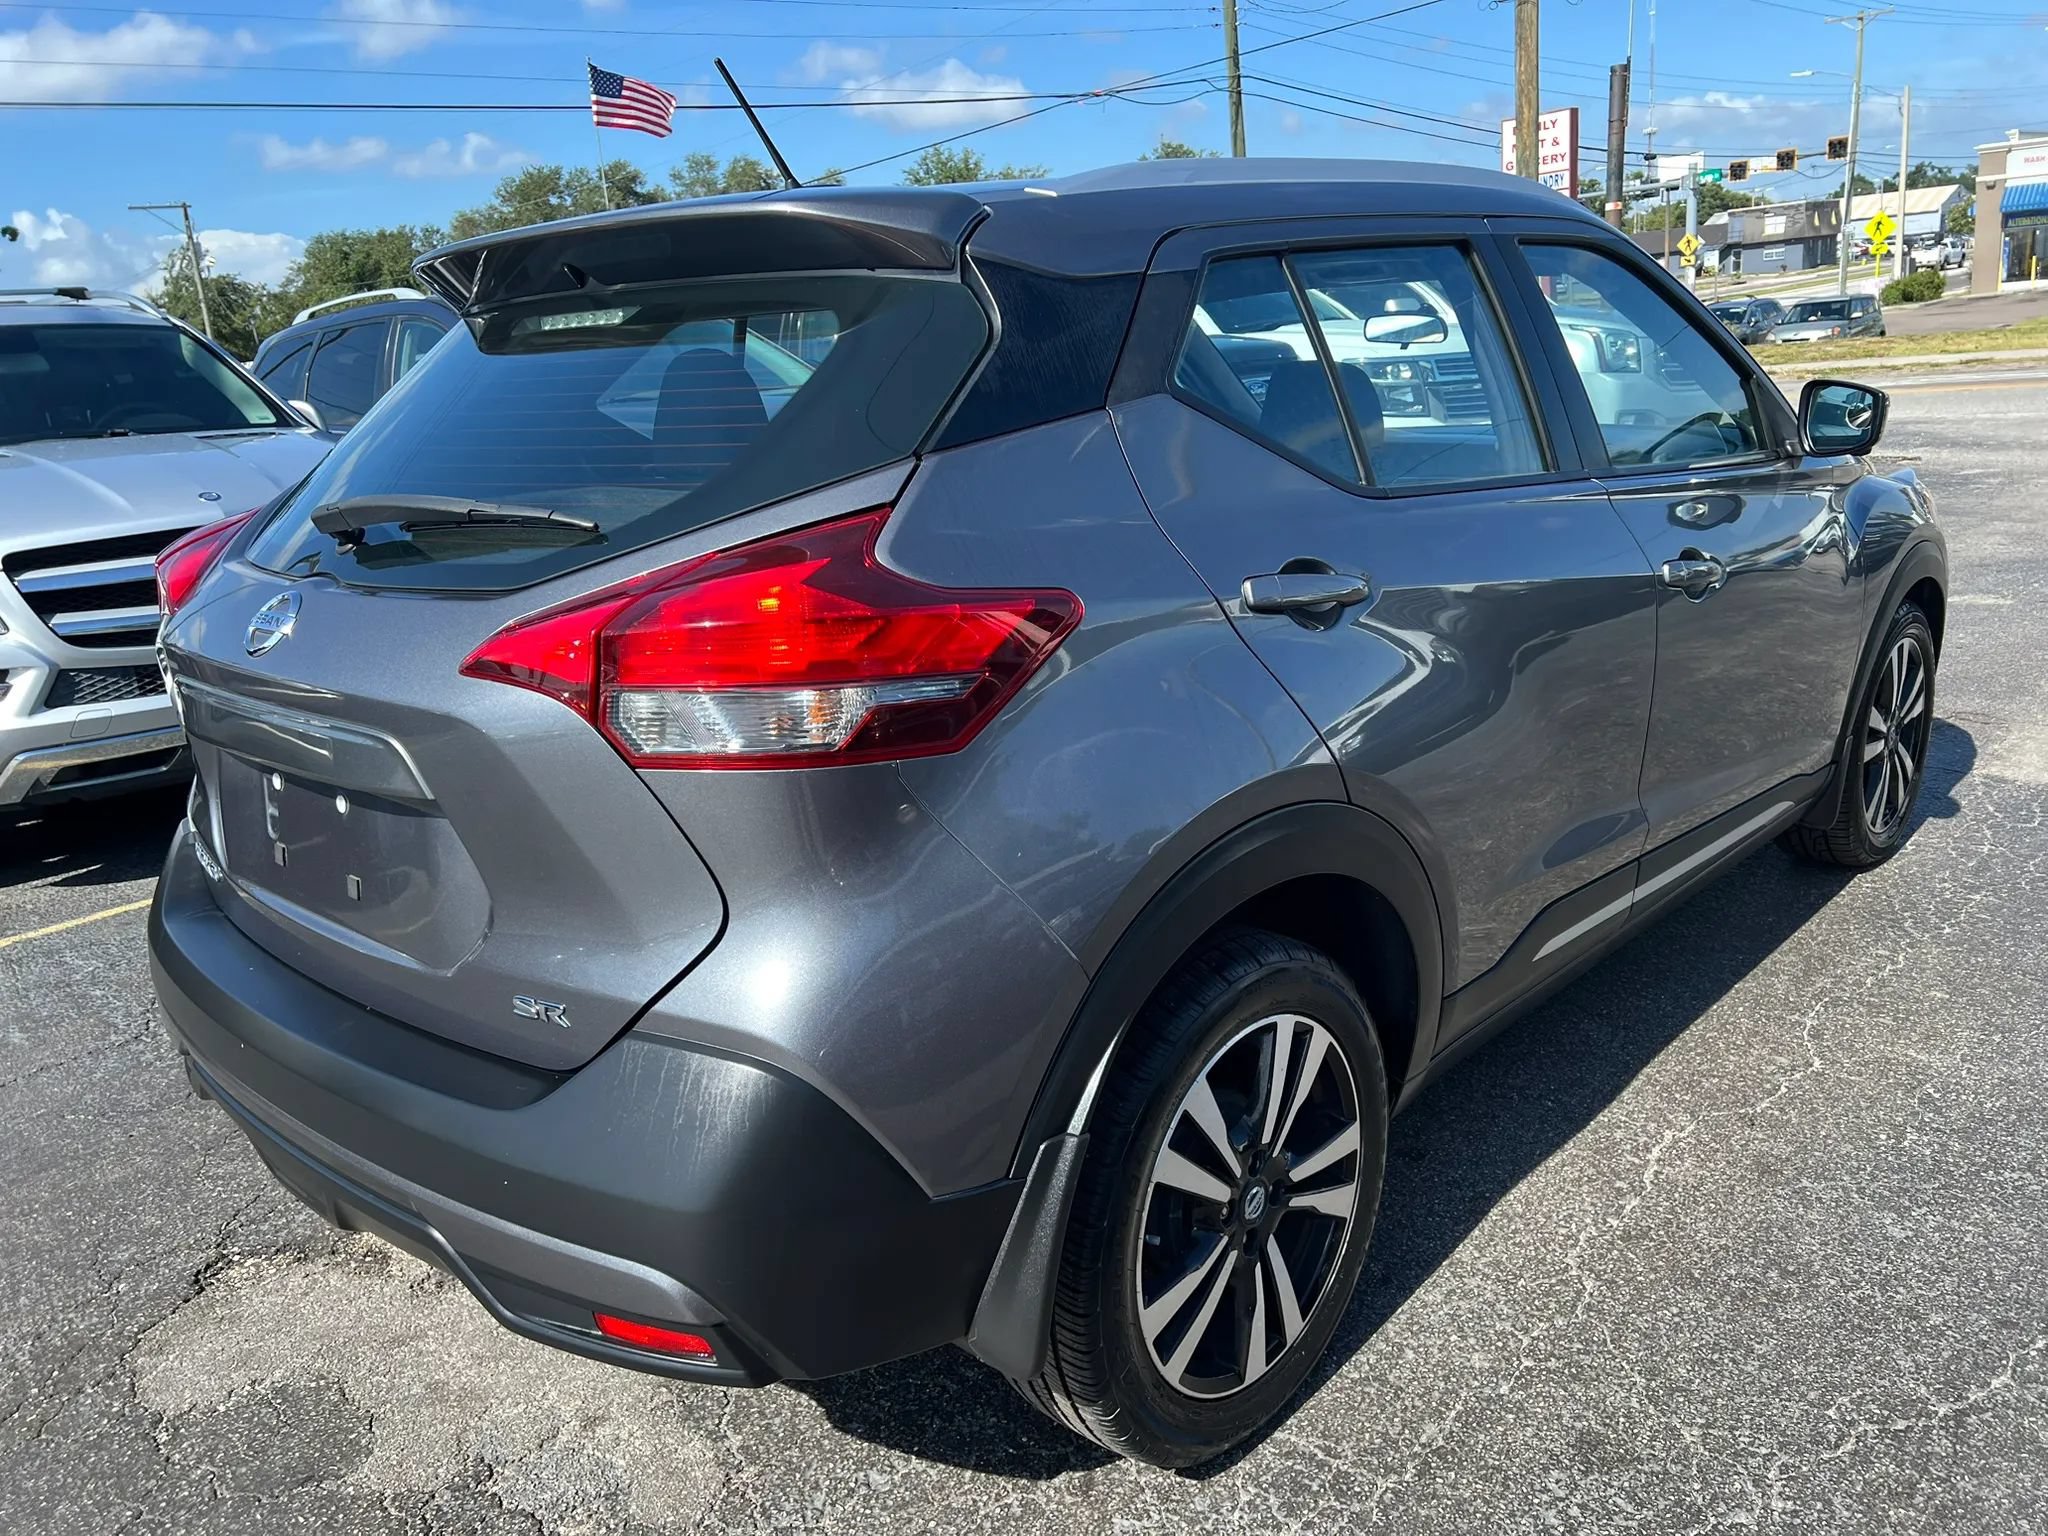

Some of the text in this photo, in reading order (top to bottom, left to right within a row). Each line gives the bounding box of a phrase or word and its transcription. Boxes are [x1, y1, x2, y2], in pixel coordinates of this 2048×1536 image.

[1551, 136, 1560, 147] &
[1505, 152, 1567, 171] GERY
[512, 994, 572, 1028] SR
